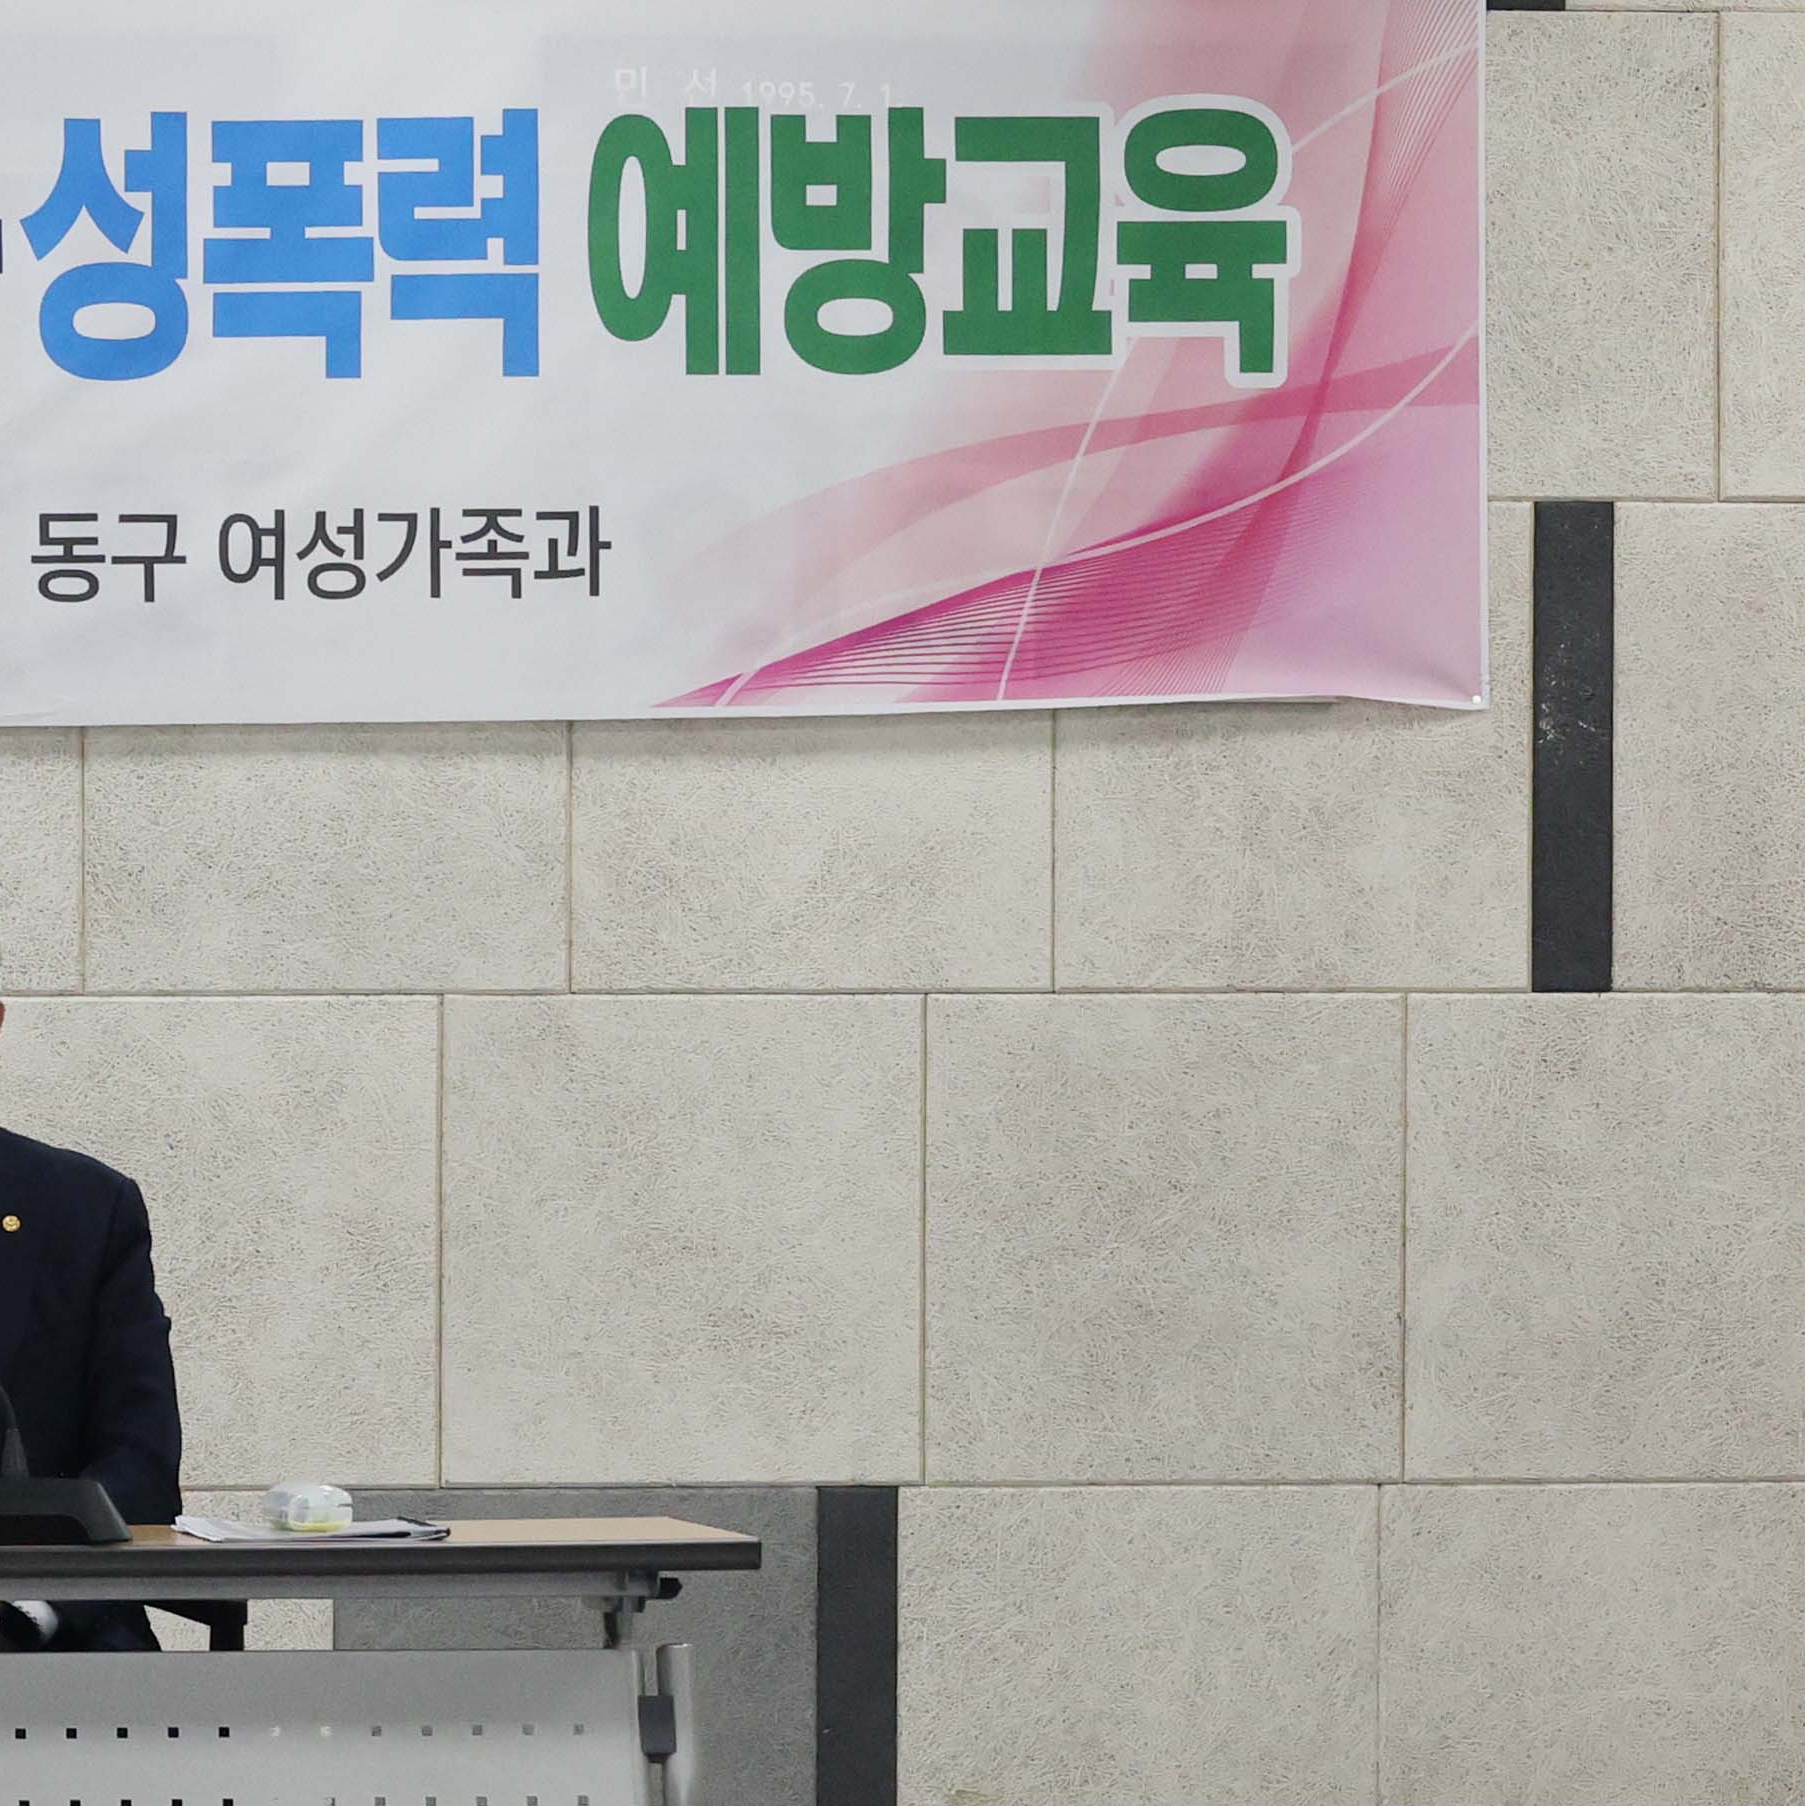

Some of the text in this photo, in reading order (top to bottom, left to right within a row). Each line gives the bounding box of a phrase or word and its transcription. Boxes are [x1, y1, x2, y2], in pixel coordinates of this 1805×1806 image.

[587, 106, 1297, 375] 예방교육
[30, 512, 188, 603] 동구
[218, 505, 612, 601] 여성가족과
